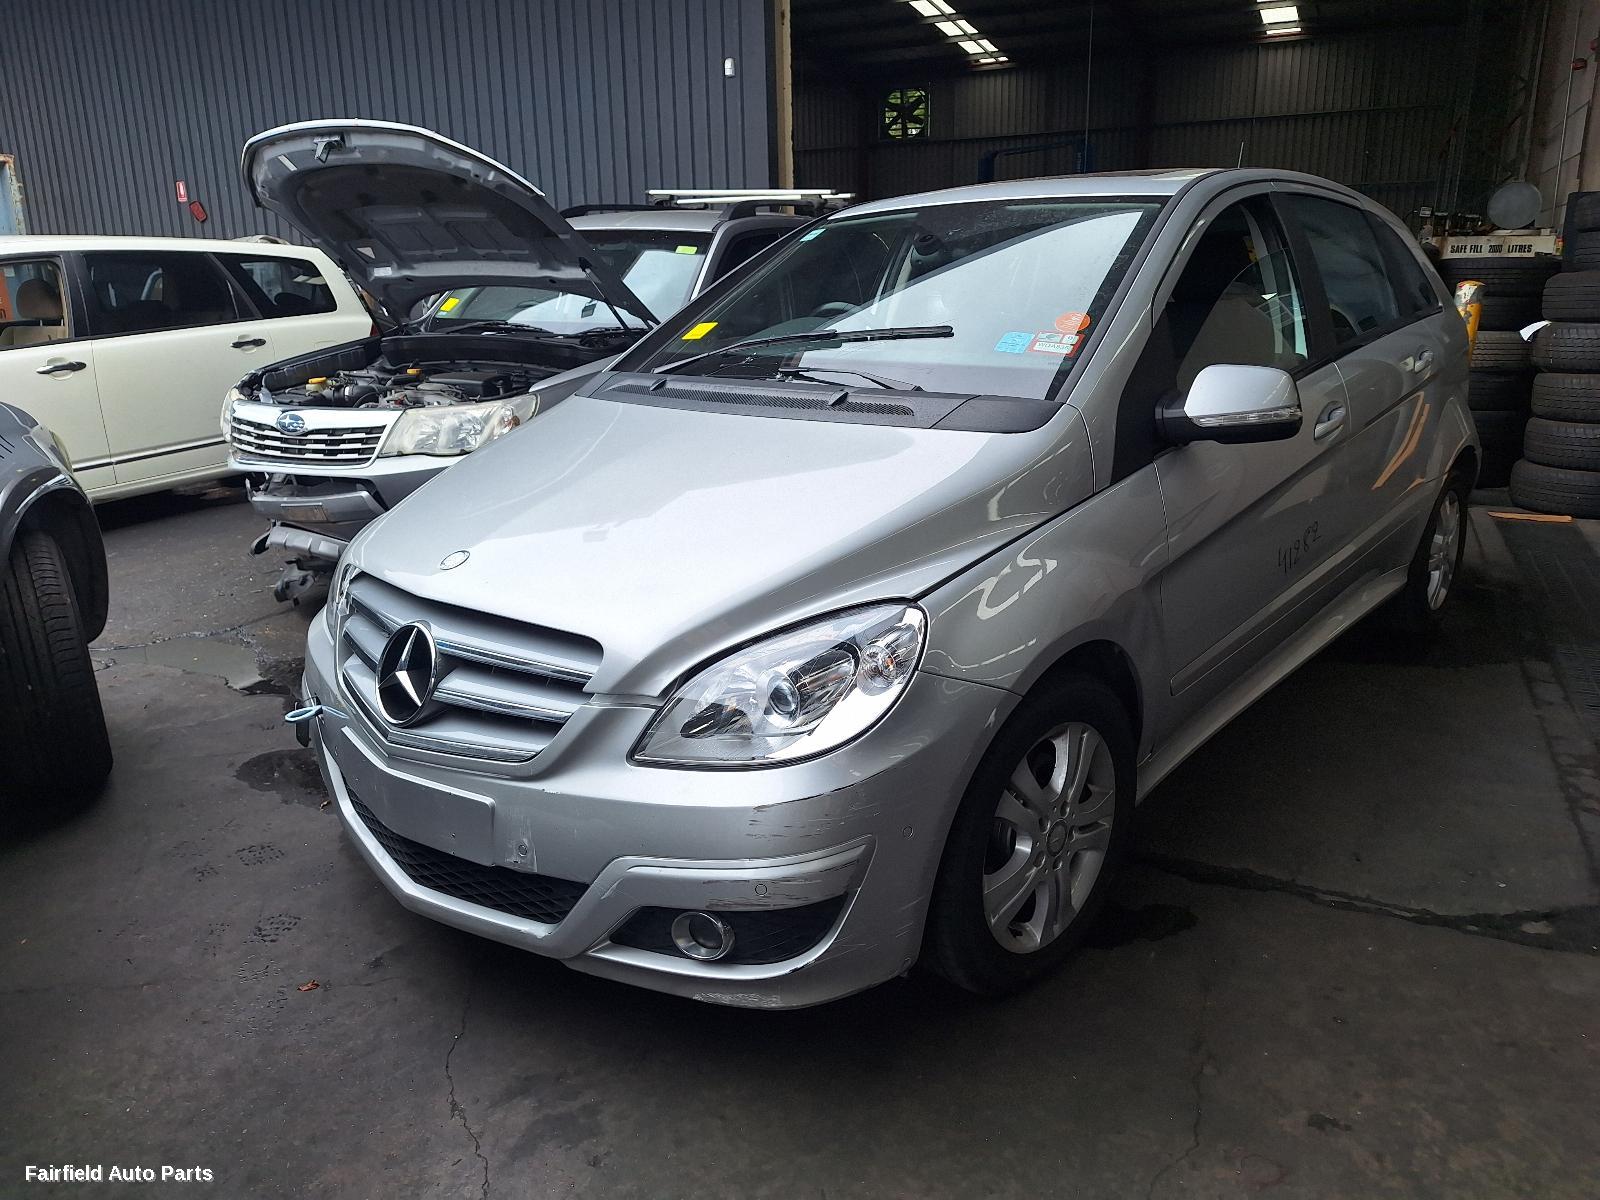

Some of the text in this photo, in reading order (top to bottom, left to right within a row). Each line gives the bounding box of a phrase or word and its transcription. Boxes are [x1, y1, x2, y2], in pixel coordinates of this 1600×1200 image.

[1450, 244, 1468, 254] SAFE
[1469, 244, 1483, 254] FILL
[1507, 244, 1533, 254] LITRES
